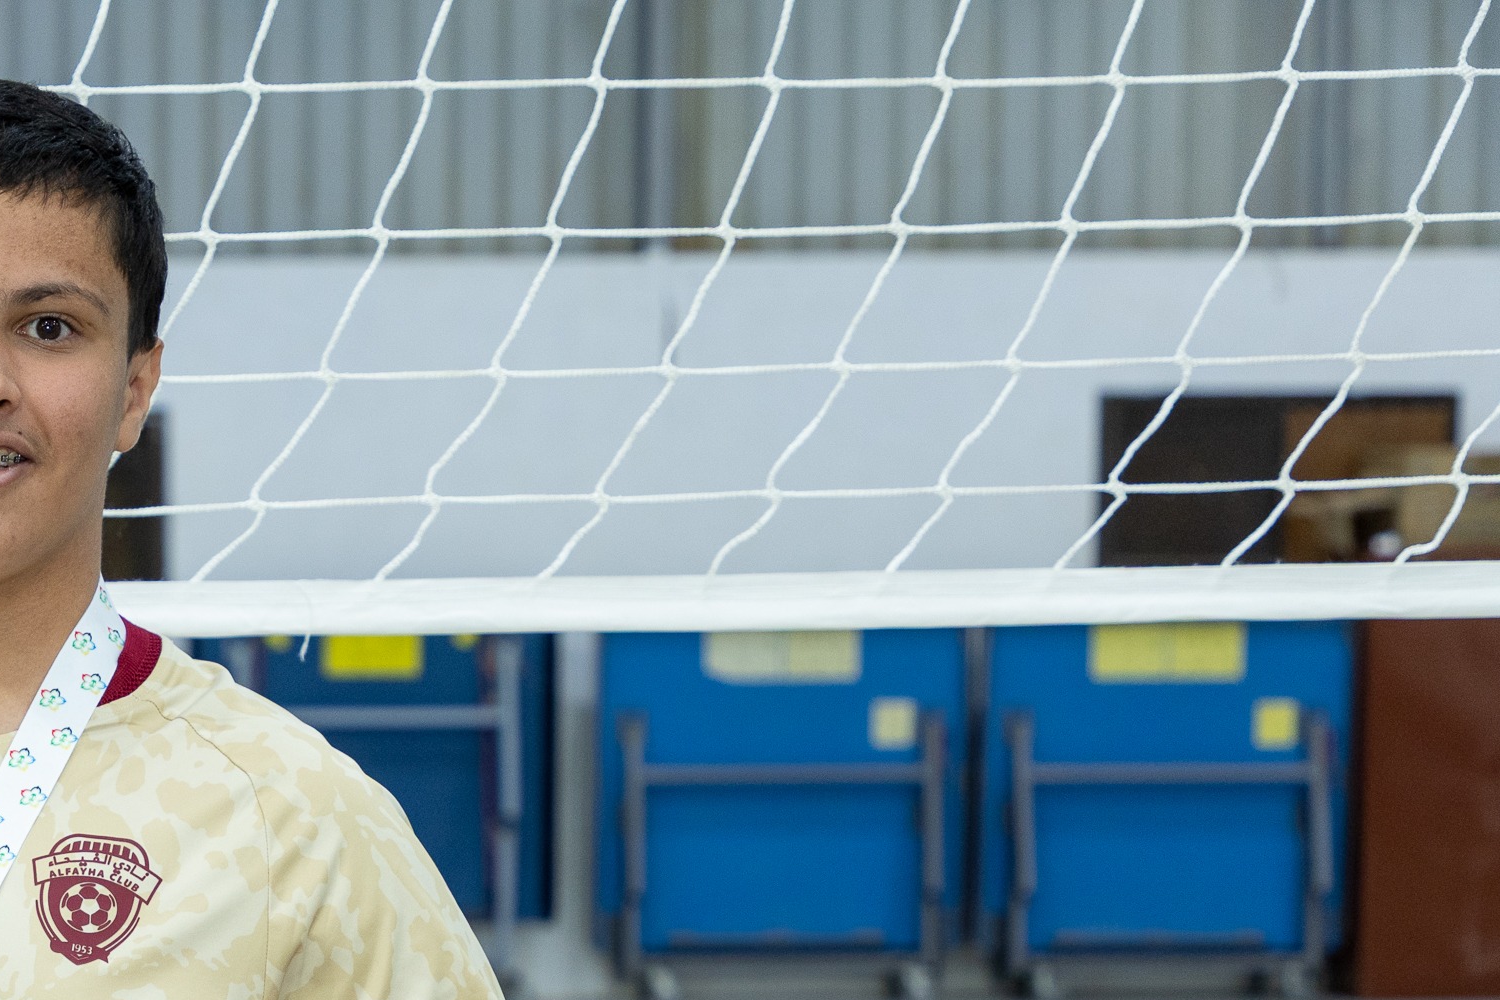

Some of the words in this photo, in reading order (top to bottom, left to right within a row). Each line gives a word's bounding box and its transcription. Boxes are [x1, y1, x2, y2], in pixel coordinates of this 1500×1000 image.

[49, 852, 112, 867] الفيحاء
[49, 867, 105, 878] ALFAYHA
[109, 873, 140, 892] CLUB
[113, 862, 150, 882] نادي
[71, 943, 93, 955] 1953
